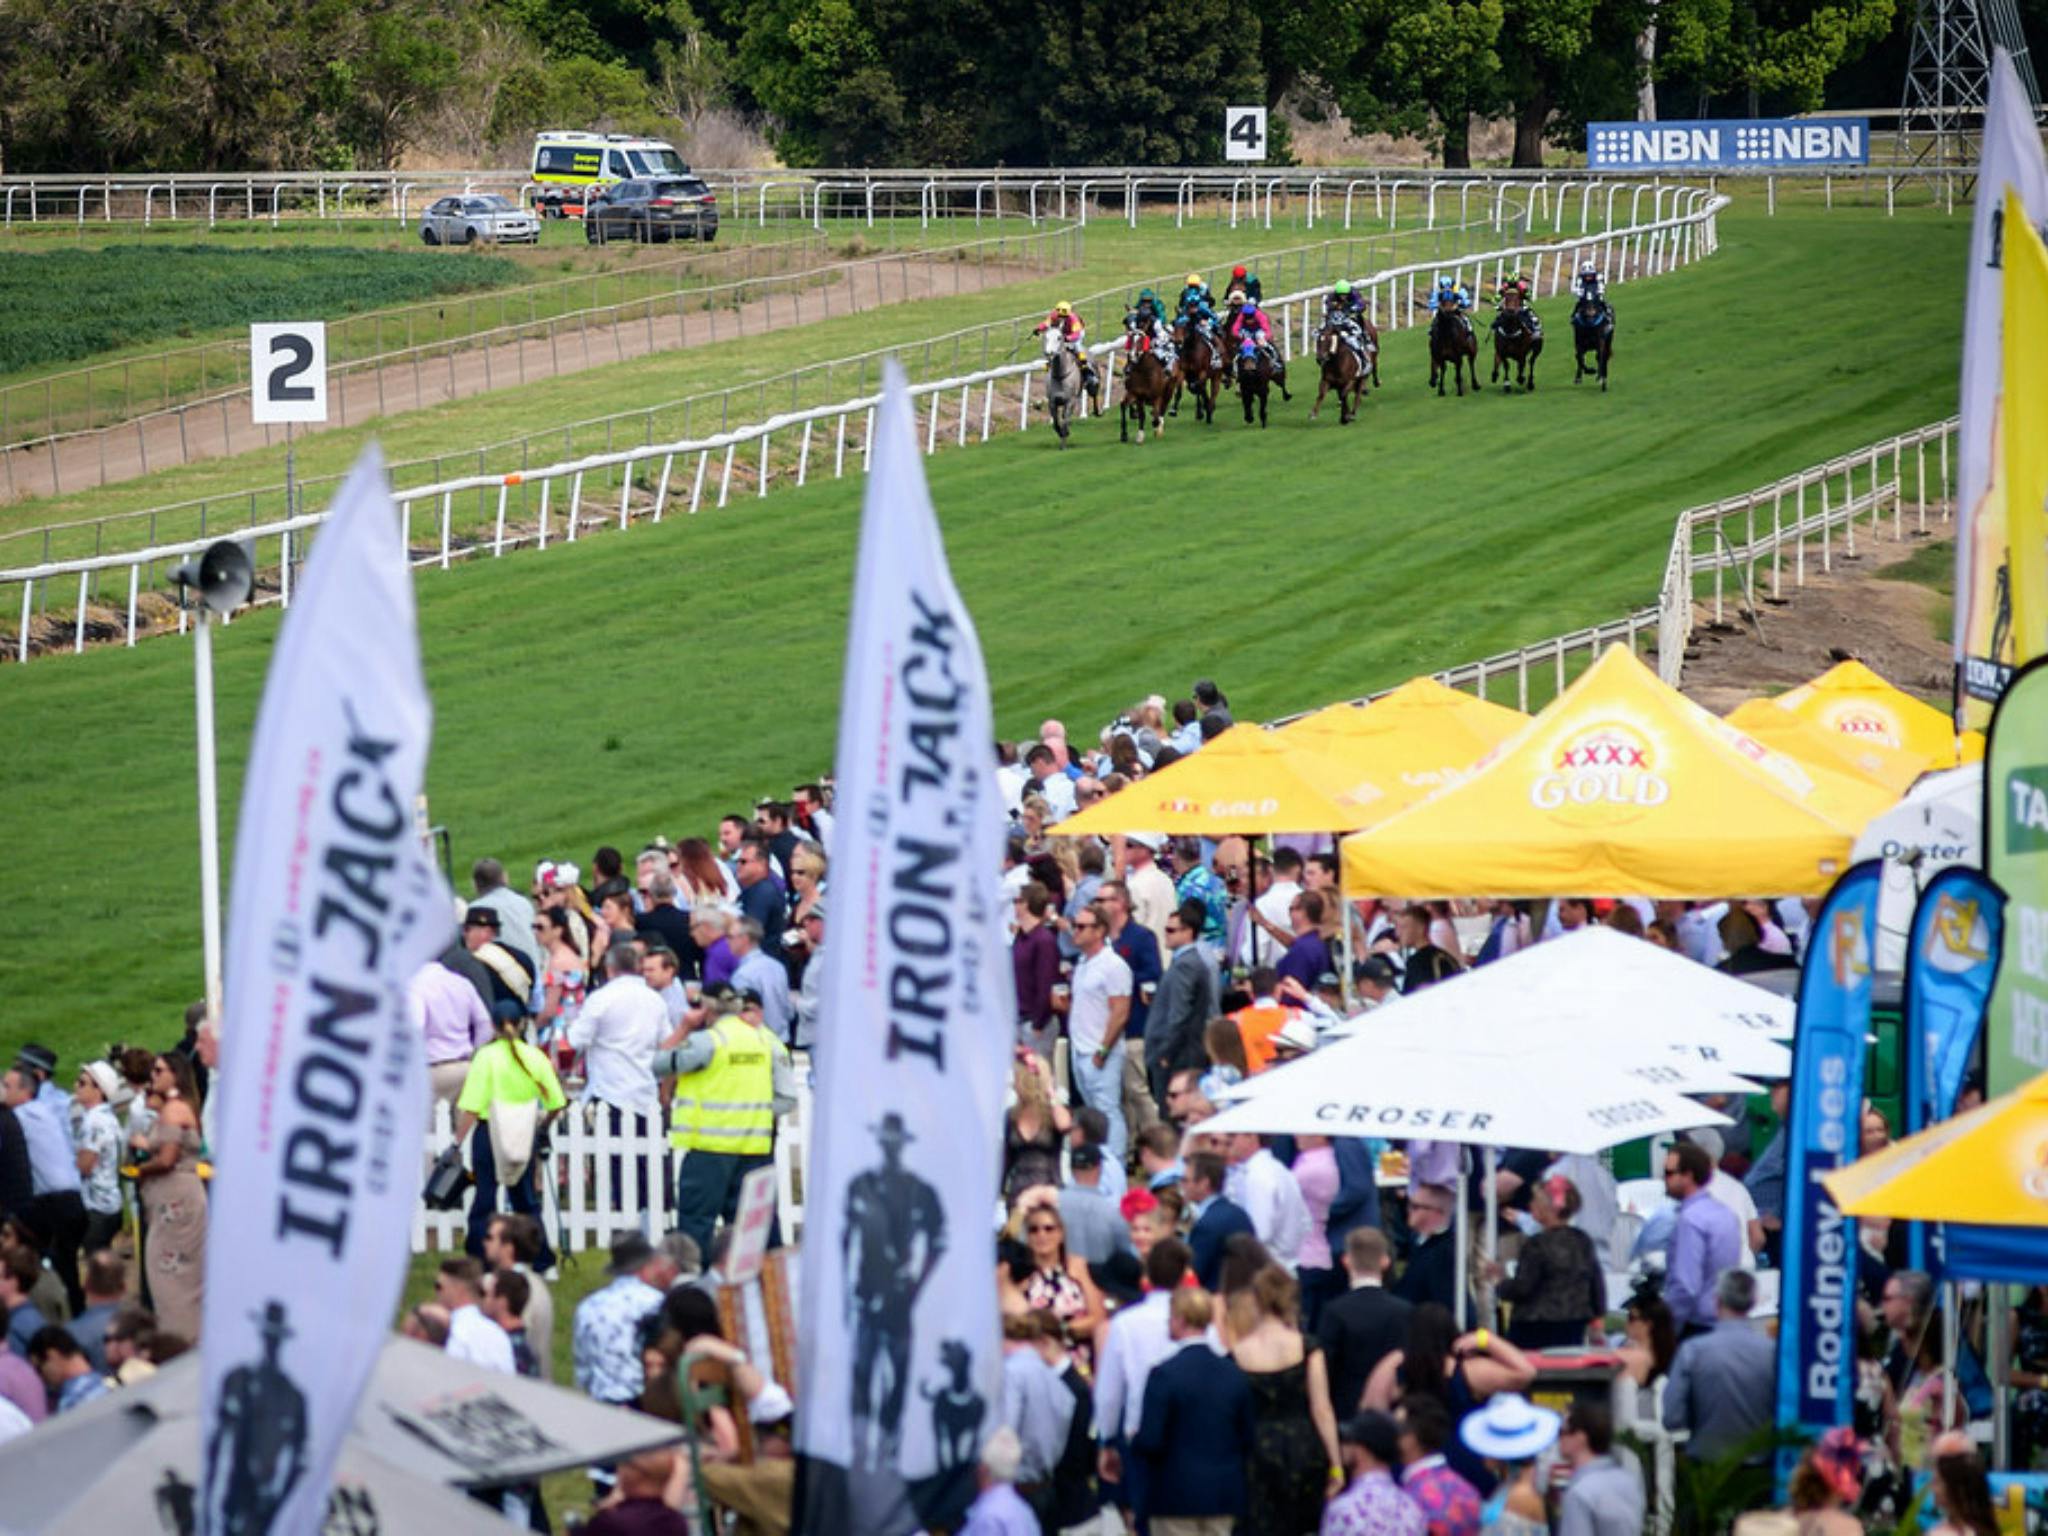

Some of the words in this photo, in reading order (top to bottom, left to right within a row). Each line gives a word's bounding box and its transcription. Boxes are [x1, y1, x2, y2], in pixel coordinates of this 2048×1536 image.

[1231, 114, 1262, 149] 4
[1632, 128, 1720, 163] NBN
[1773, 126, 1860, 160] NBN
[268, 333, 315, 401] 2
[900, 589, 960, 827] JACK
[1558, 744, 1648, 769] XXXX
[1530, 772, 1670, 809] GOLD
[1881, 840, 1968, 866] Oter
[885, 834, 961, 1075] IRON
[275, 975, 380, 1261] IRON
[1315, 1102, 1494, 1130] CROSER
[1808, 1202, 1847, 1401] Rodney
